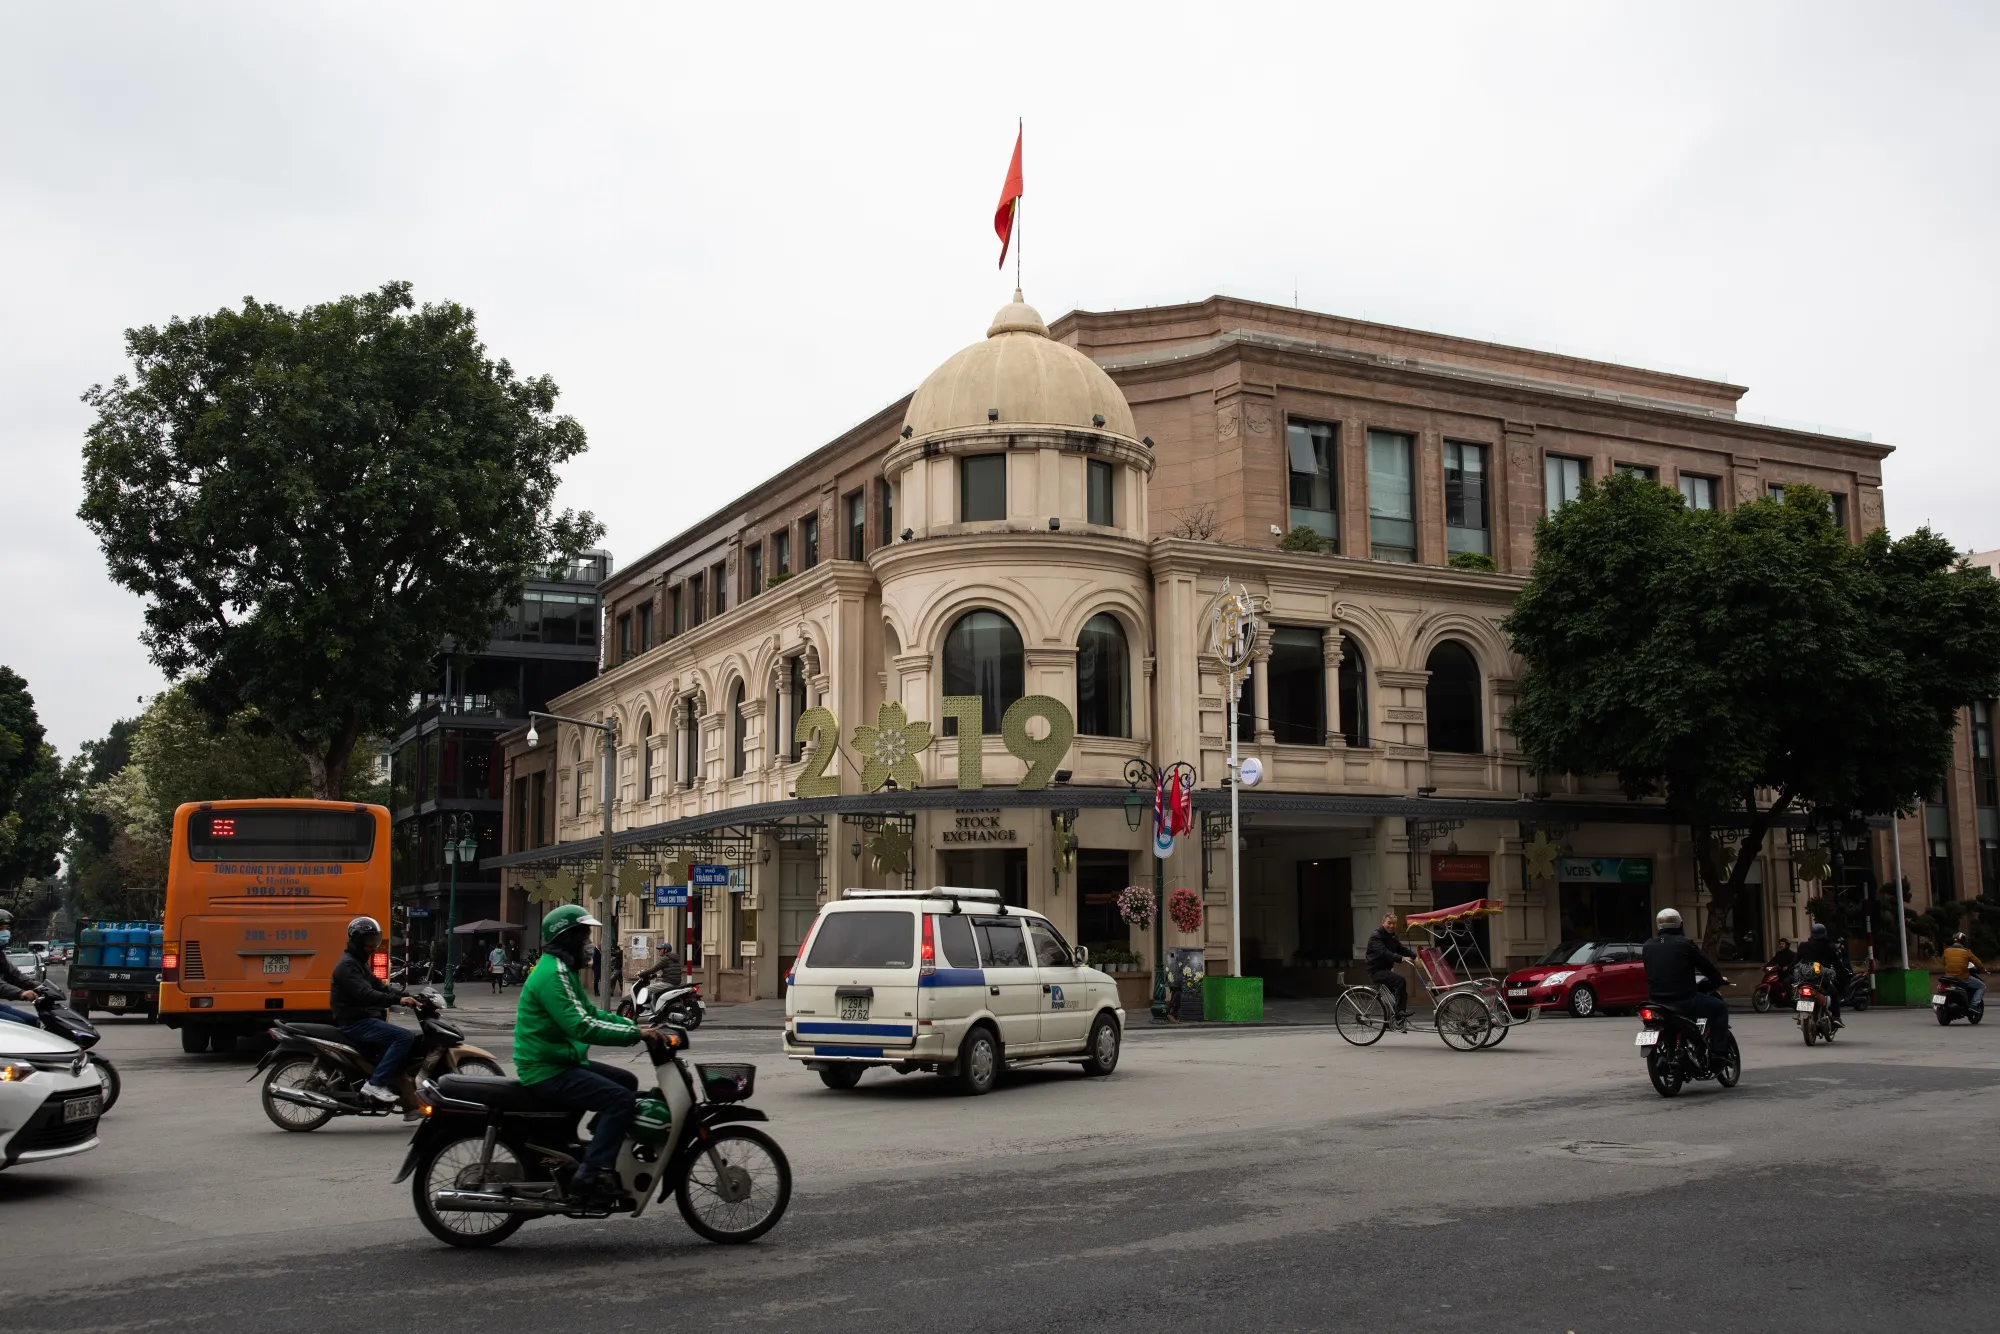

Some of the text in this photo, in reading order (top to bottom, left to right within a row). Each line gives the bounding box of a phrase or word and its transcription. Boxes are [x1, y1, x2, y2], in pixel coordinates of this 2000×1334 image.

[955, 816, 1000, 828] STOCK
[942, 829, 1017, 842] EXCHANGE
[1564, 866, 1591, 877] VCBS
[265, 876, 300, 885] Hotline
[548, 918, 569, 933] Grab
[848, 998, 863, 1009] 29A
